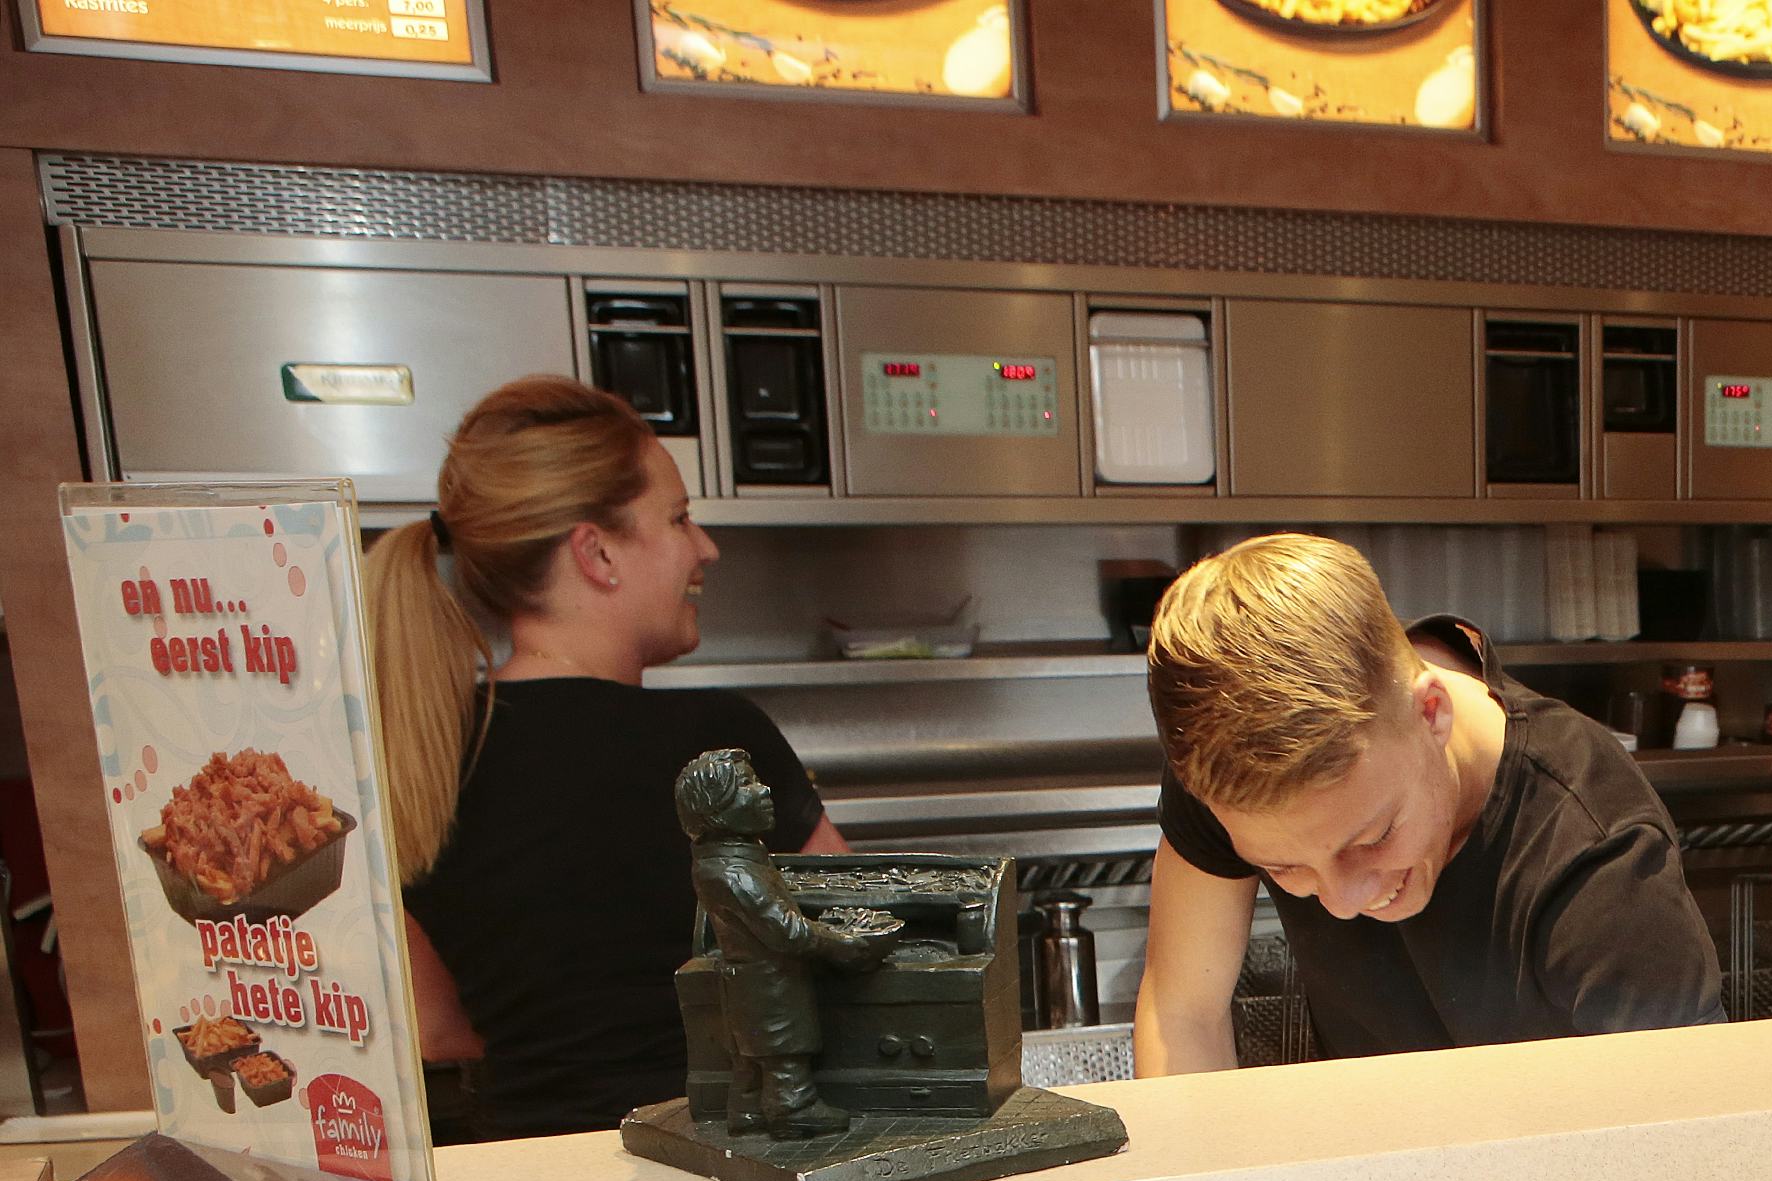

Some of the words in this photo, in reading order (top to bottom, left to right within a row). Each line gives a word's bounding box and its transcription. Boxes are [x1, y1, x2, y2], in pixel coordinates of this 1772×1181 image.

[324, 16, 388, 34] meerprijs
[405, 24, 438, 39] 0,25
[121, 580, 162, 615] en
[169, 578, 247, 614] nu...
[151, 628, 234, 677] eerst
[240, 624, 298, 685] kip
[196, 914, 319, 981] patatje
[226, 969, 305, 1027] hete
[308, 977, 370, 1046] kip
[315, 1105, 381, 1159] family
[335, 1143, 369, 1160] chicken
